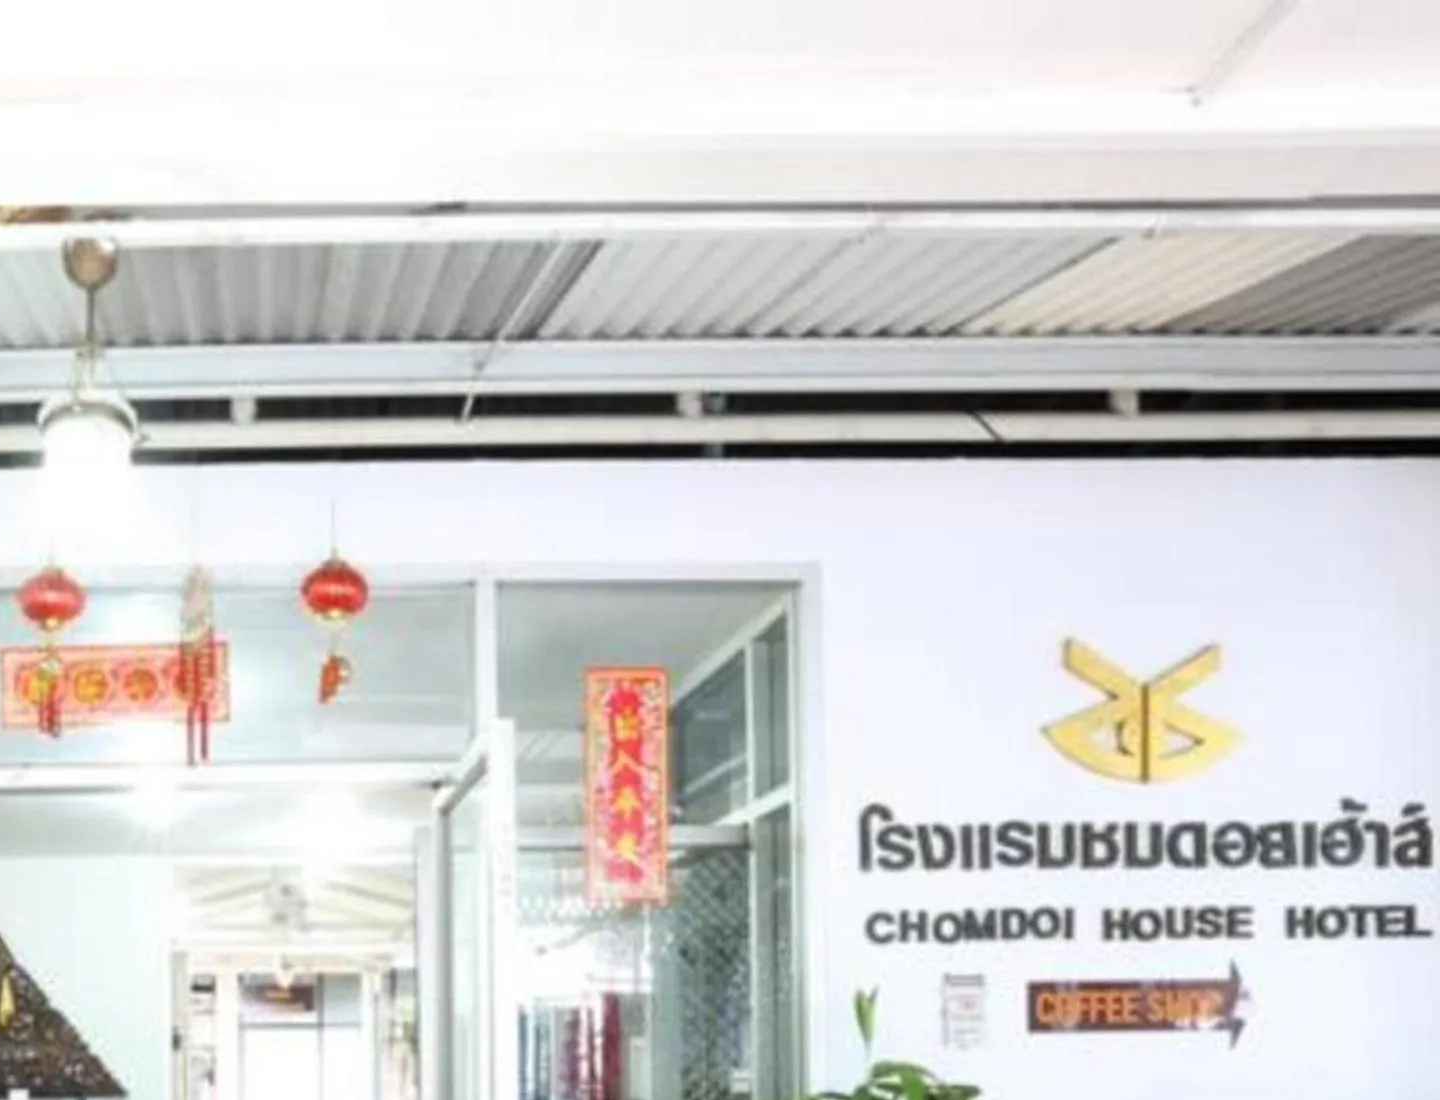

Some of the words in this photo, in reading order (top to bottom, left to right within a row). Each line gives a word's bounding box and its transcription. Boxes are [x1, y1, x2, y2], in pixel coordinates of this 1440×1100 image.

[859, 797, 1435, 872] โรงแรมชมดอยเฮ้าส์
[865, 907, 1075, 944] CHOMDOI
[1101, 905, 1254, 941] HOUSE
[1284, 904, 1434, 939] HOTEL
